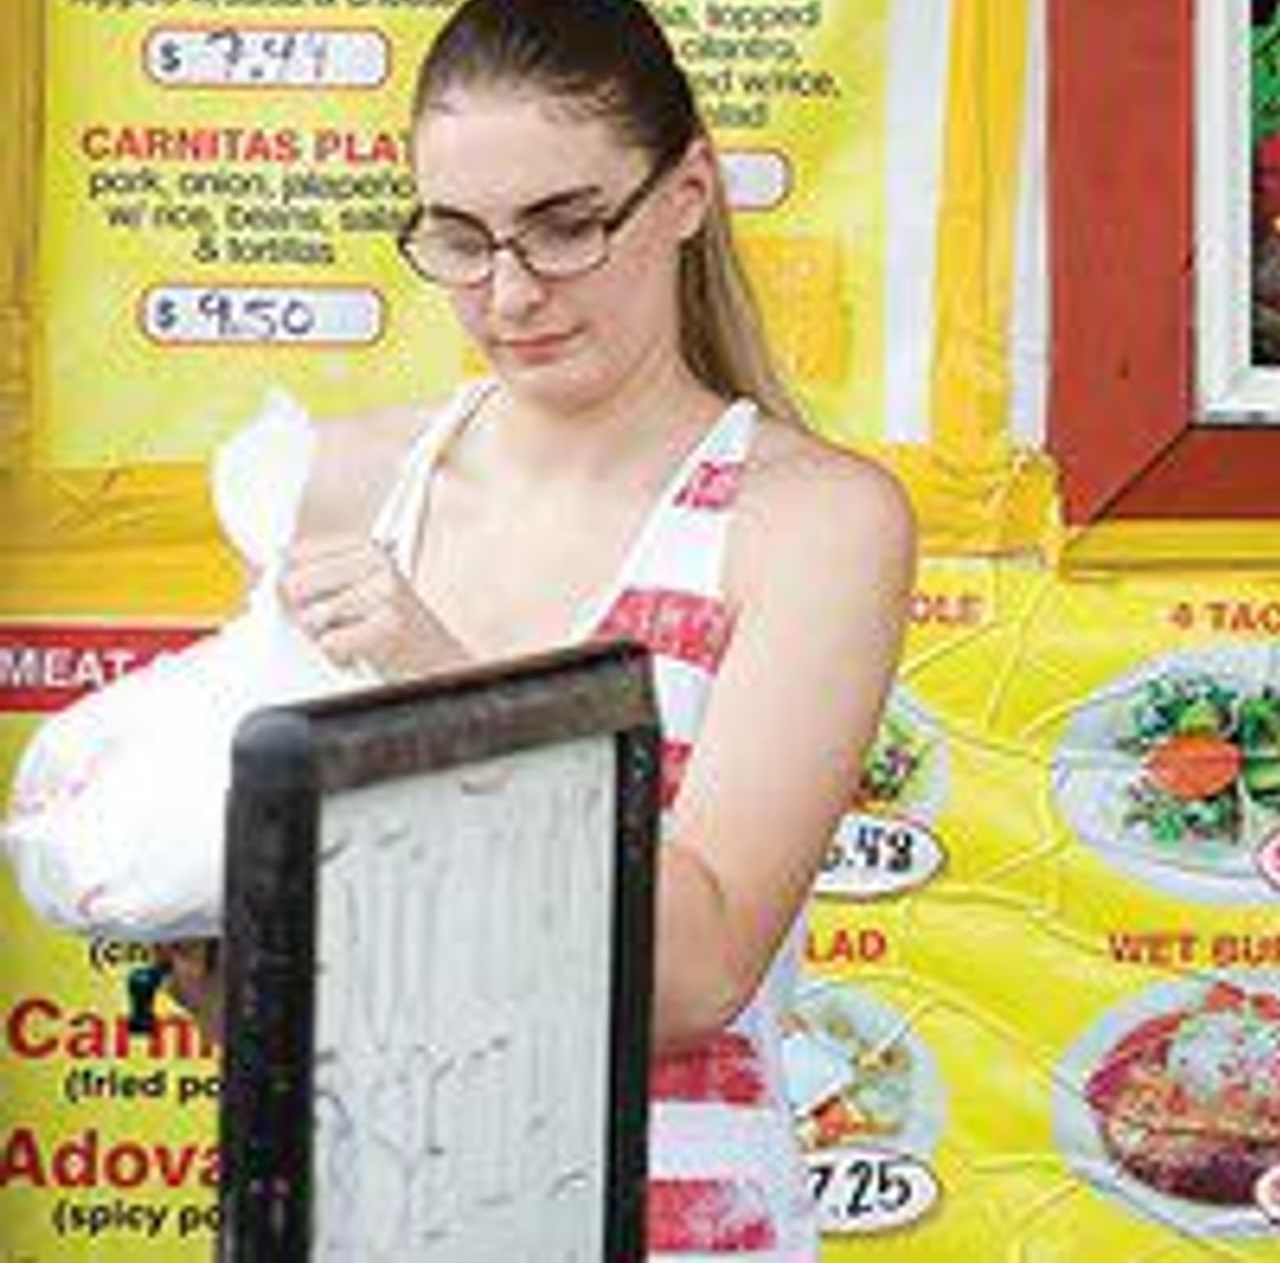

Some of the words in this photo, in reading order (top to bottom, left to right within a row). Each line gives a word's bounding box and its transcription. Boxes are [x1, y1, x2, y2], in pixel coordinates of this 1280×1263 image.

[705, 1, 820, 32] topped
[81, 127, 300, 163] CARNITAS
[340, 208, 402, 232] sala
[194, 239, 218, 264] &
[227, 237, 333, 264] tortillas
[1170, 605, 1193, 629] 4
[1109, 935, 1198, 965] WET
[64, 1070, 165, 1105] (fried
[53, 1200, 167, 1237] (spicy
